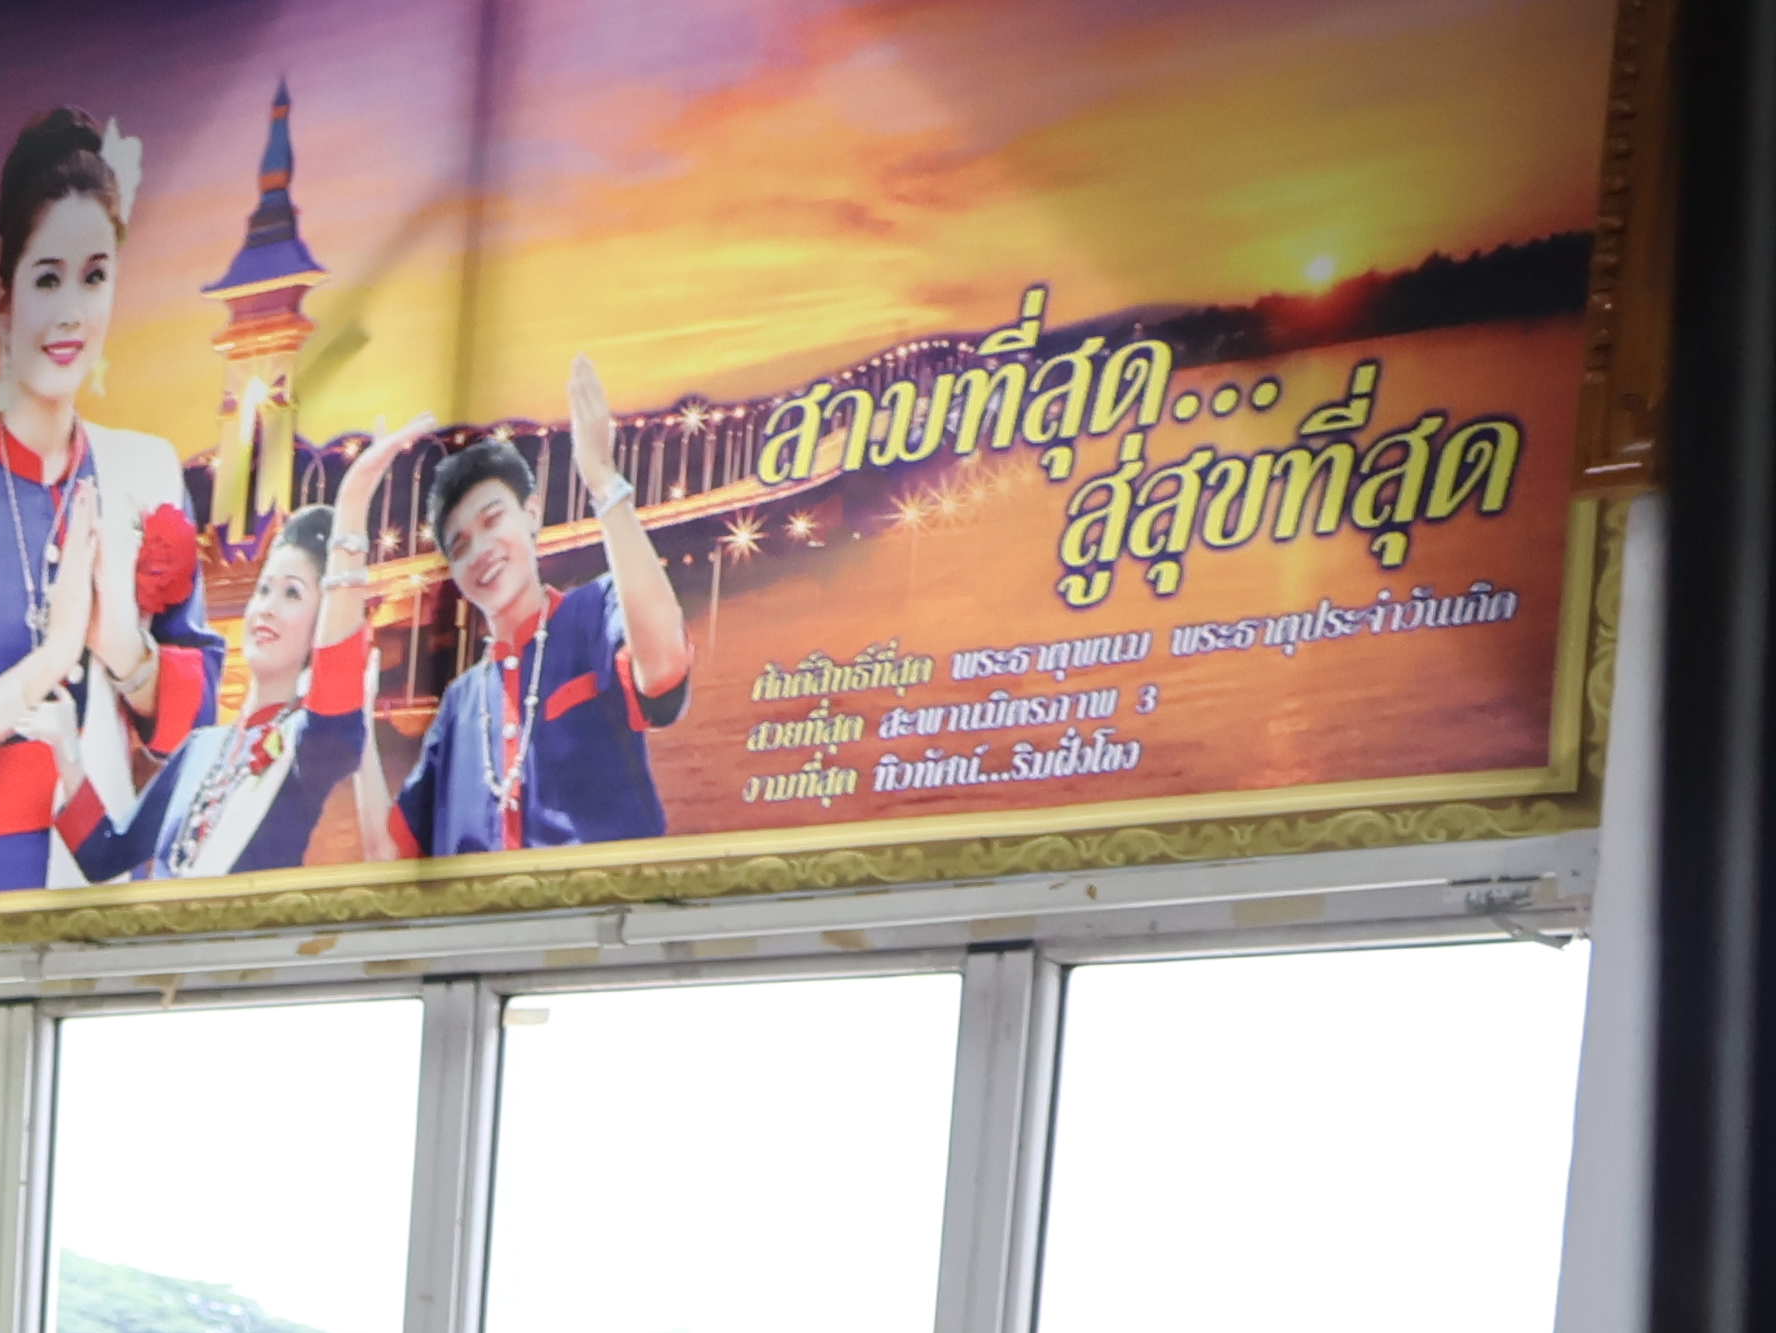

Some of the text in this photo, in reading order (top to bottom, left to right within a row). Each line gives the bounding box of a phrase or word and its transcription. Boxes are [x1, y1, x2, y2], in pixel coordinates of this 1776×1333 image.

[756, 285, 1280, 482] สามที่สุด...
[1058, 361, 1522, 607] สู่สุขที่สุด
[751, 581, 1519, 701] ศักดิ์สิทธิ์ที่สุด พระธาตุพนม พระธาตุประจำวันเกิด
[742, 750, 859, 808] งามที่สุด
[746, 683, 1159, 755] สวยที่สุด สะพานมิตรภาพ 3
